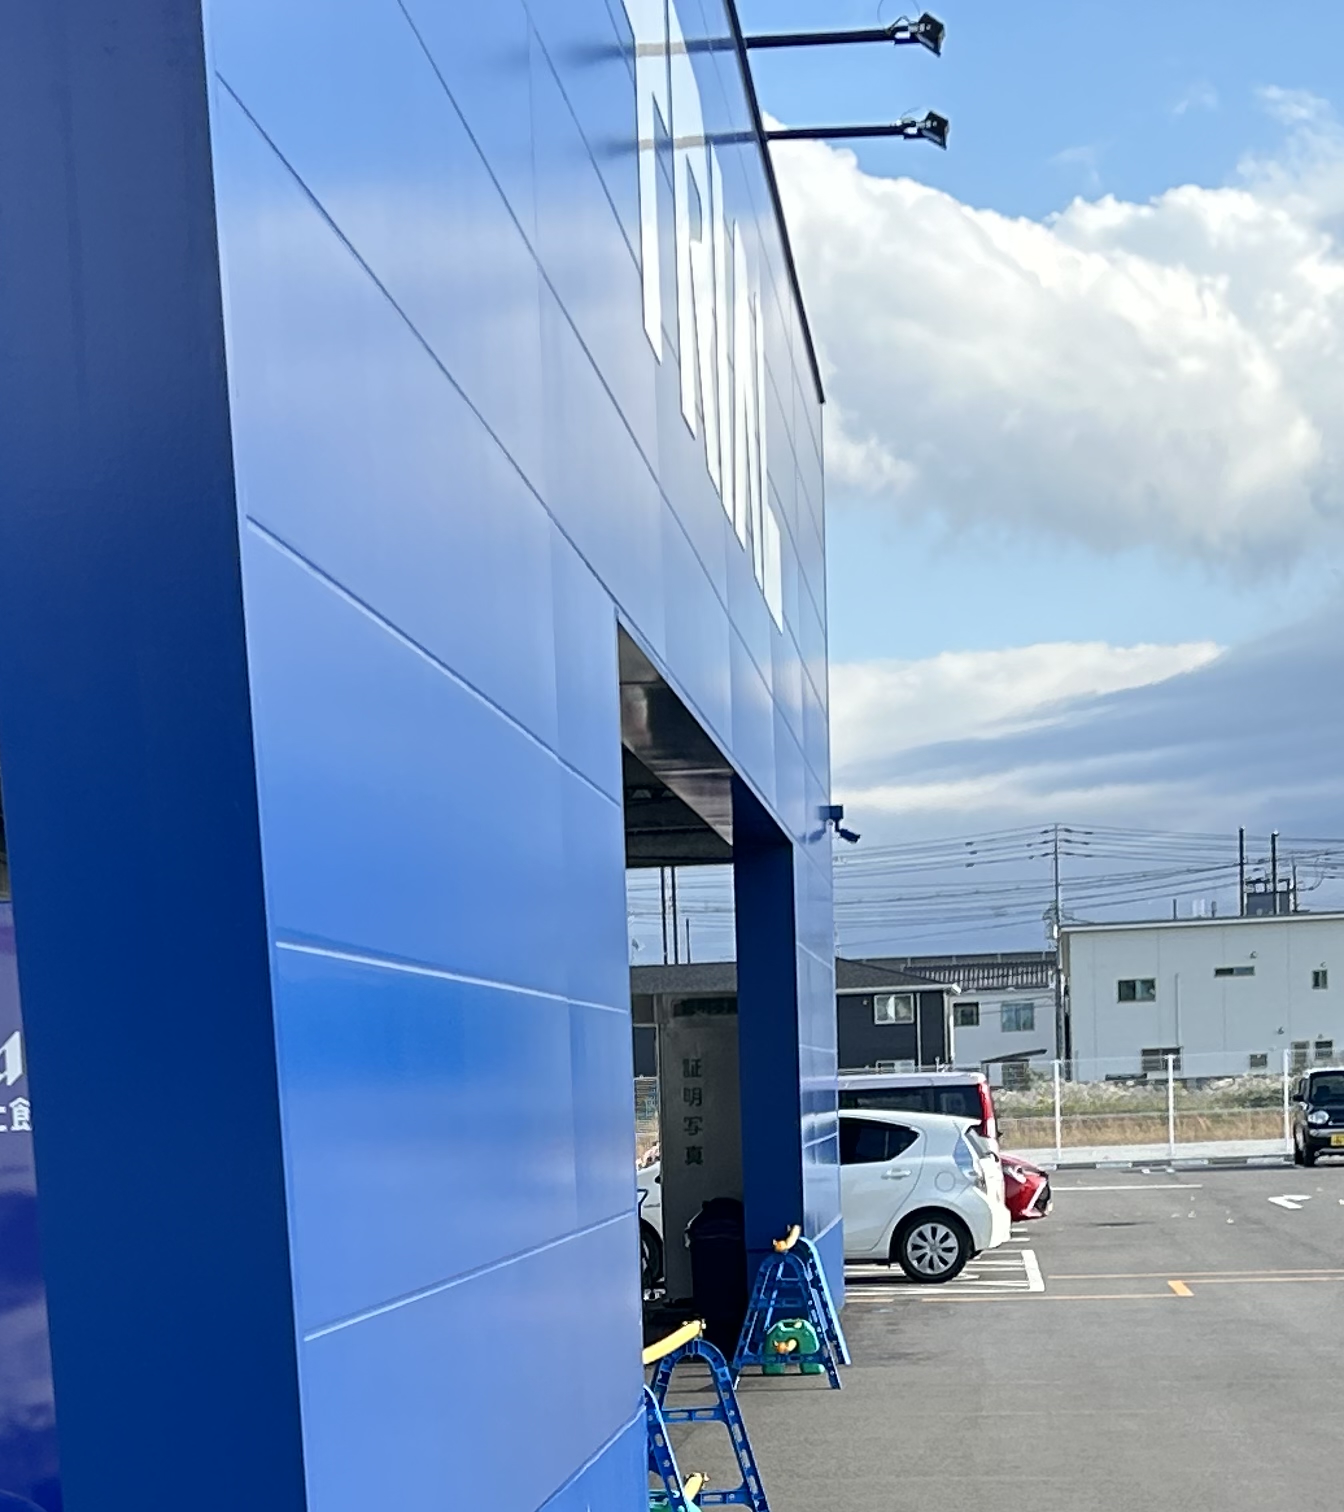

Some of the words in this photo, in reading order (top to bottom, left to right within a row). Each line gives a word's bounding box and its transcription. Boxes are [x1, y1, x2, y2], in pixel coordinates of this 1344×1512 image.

[620, 0, 784, 636] TRIAL
[682, 1058, 704, 1166] 証明写真
